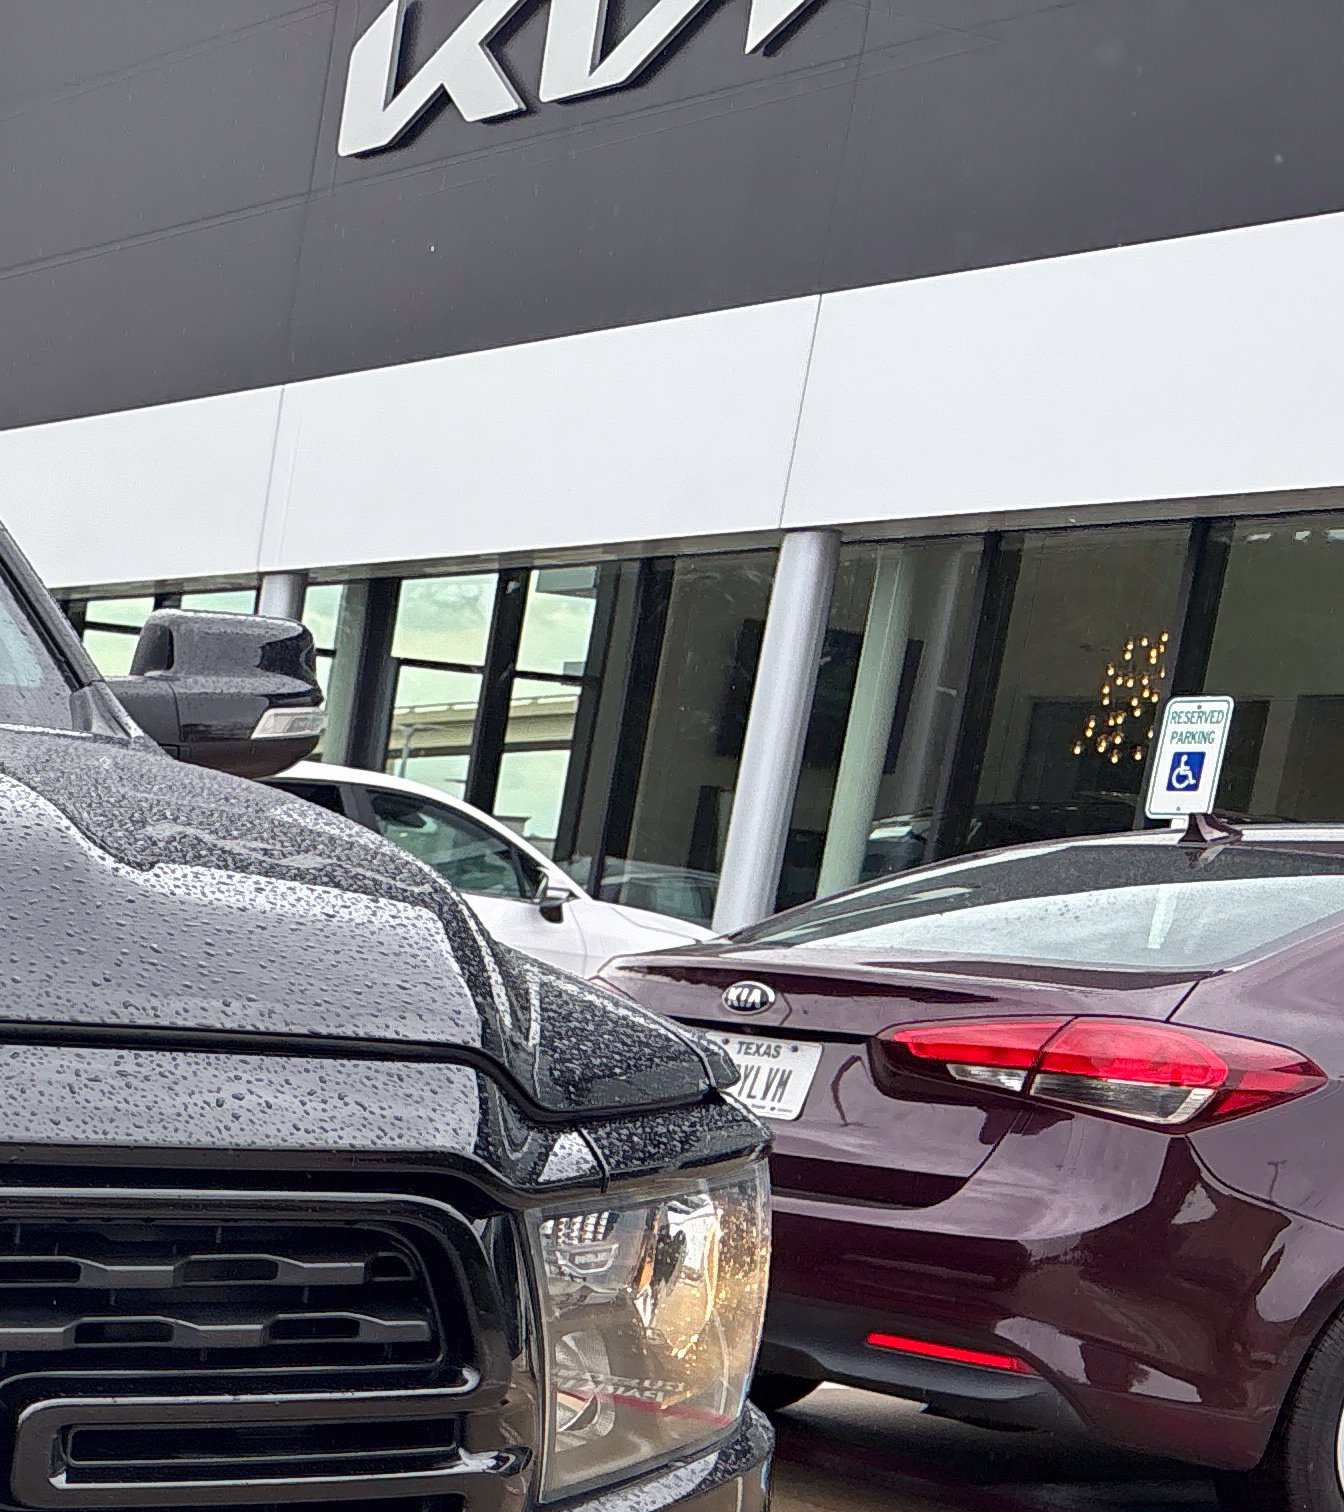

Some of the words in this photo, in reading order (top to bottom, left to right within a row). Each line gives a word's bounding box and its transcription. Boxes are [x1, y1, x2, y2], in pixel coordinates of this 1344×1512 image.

[1170, 710, 1224, 724] RESERVED
[1170, 731, 1215, 744] PARKING
[727, 987, 762, 1008] KIA
[737, 1041, 782, 1058] TEXAS
